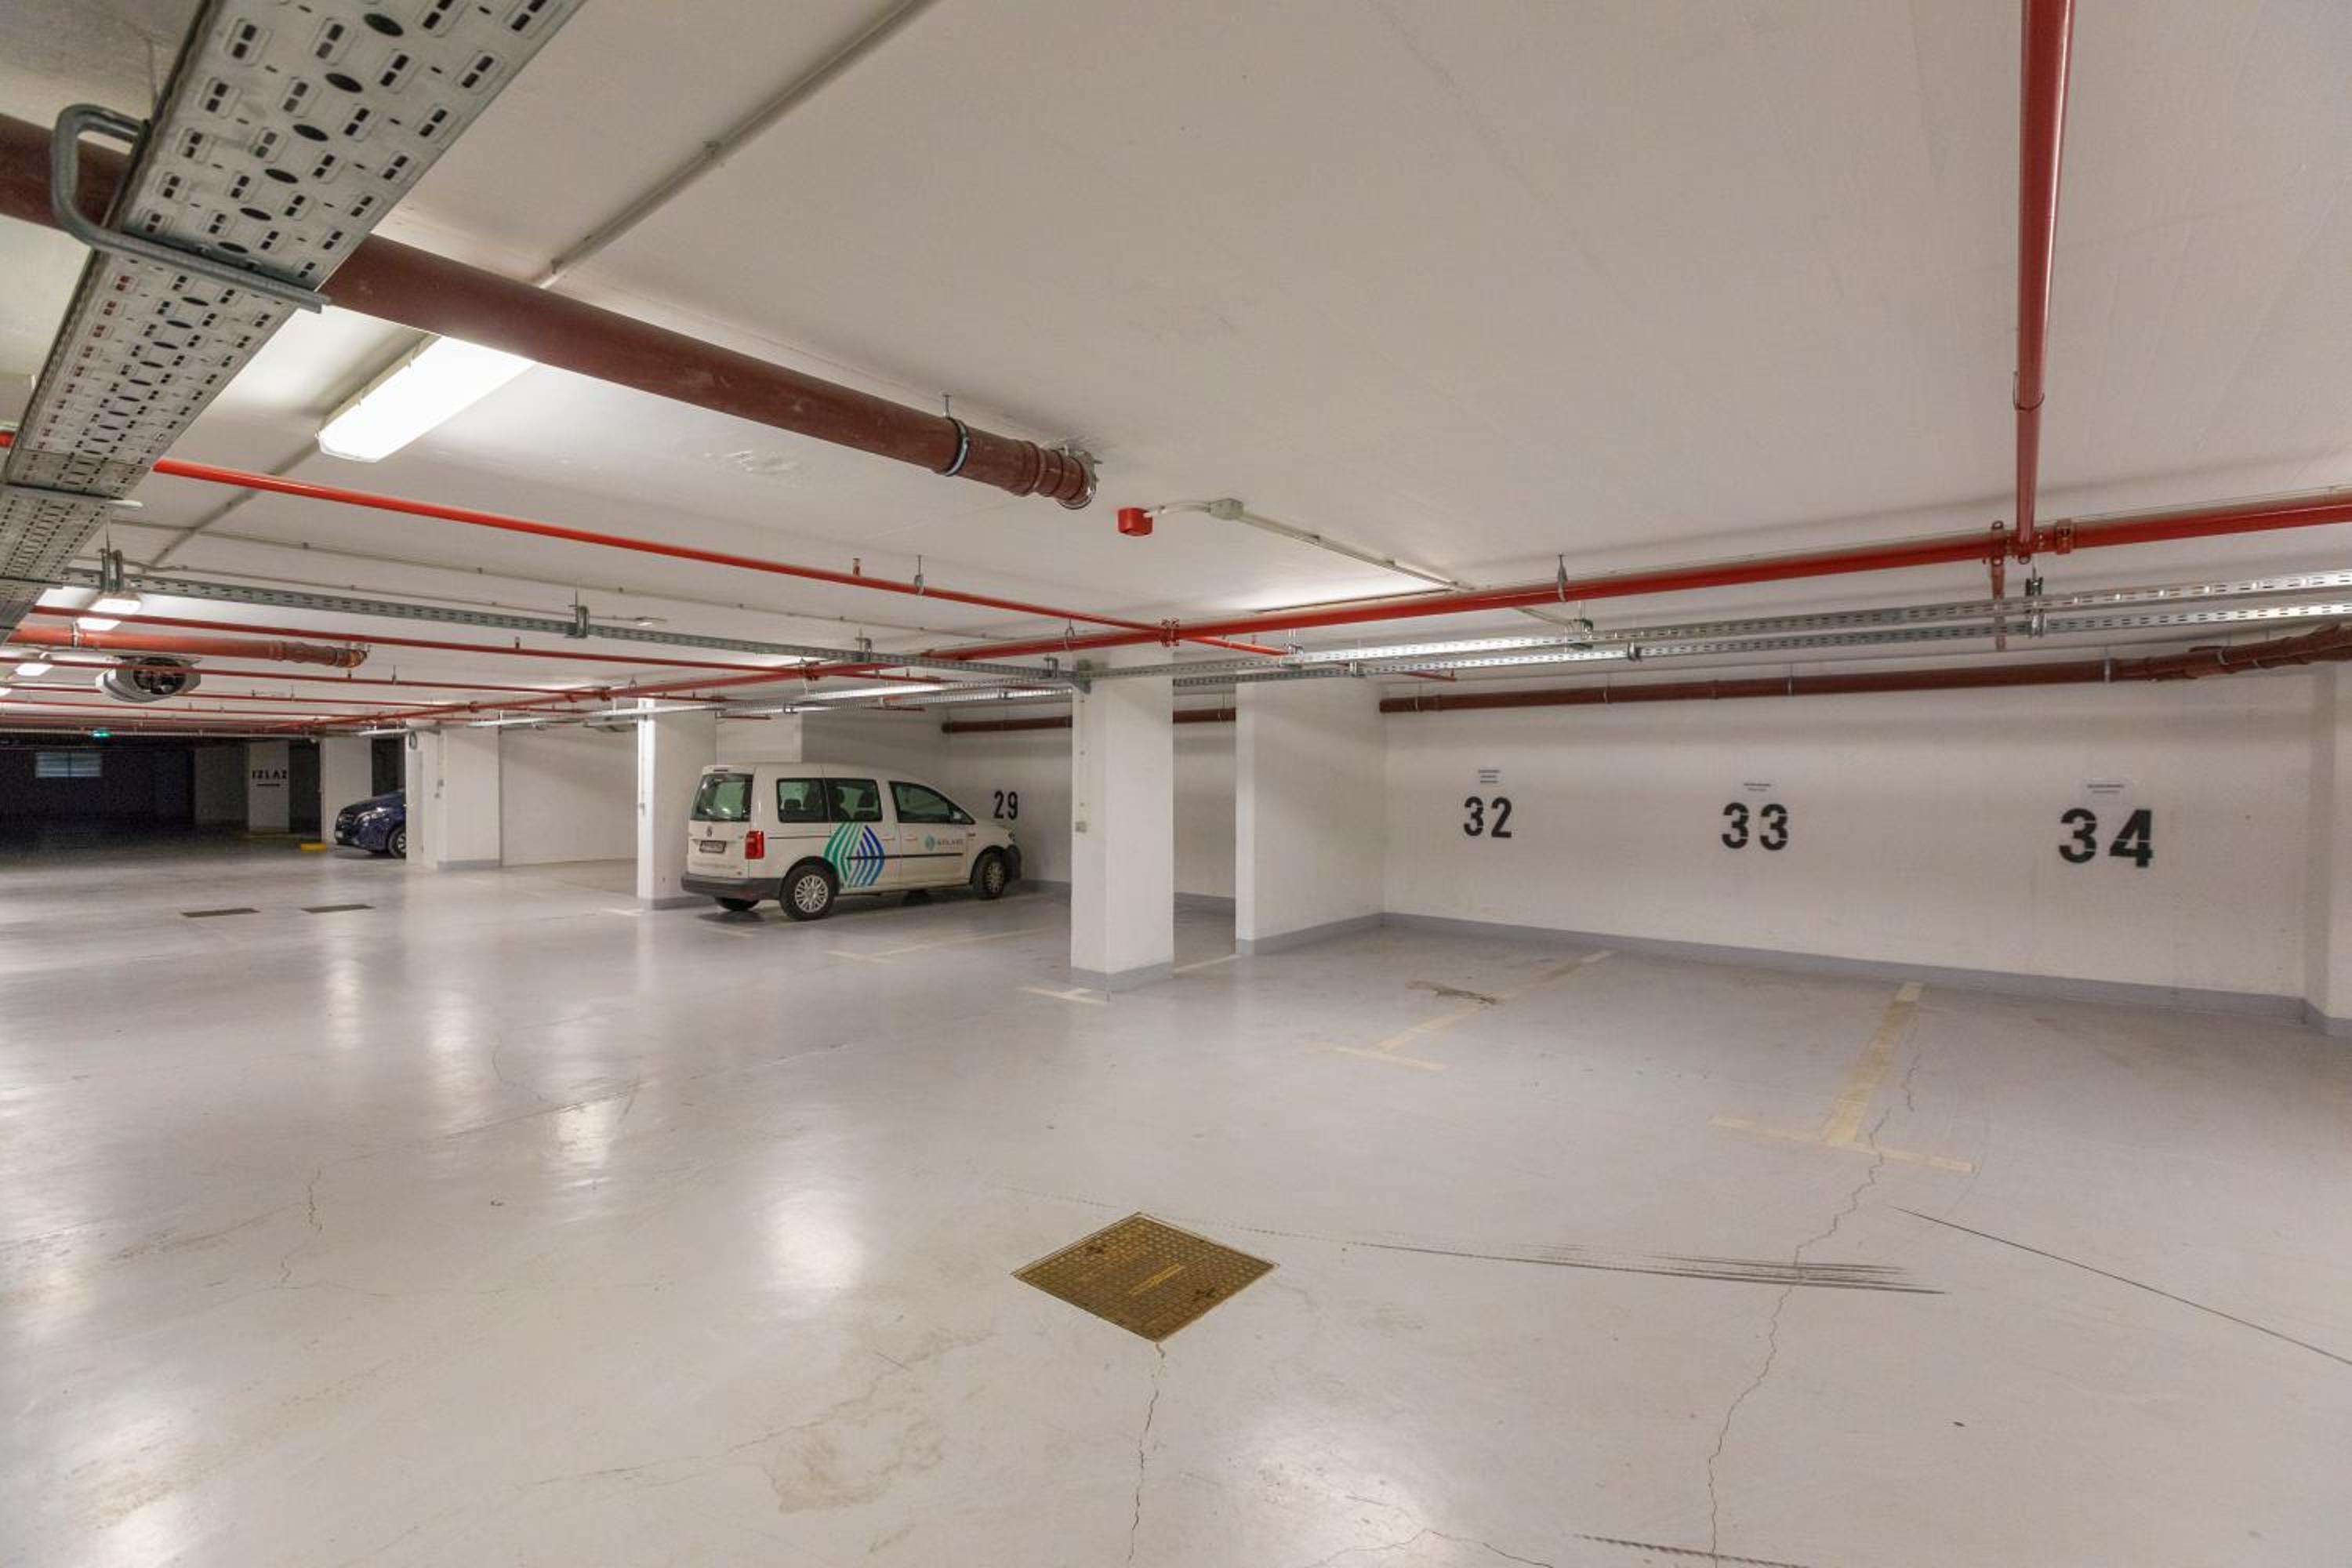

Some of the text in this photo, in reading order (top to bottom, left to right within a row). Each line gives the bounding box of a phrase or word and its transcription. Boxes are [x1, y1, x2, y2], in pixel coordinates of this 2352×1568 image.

[993, 789, 1018, 820] 29
[1464, 796, 1512, 838] 32
[1721, 802, 1788, 851] 33
[2059, 807, 2154, 868] 34
